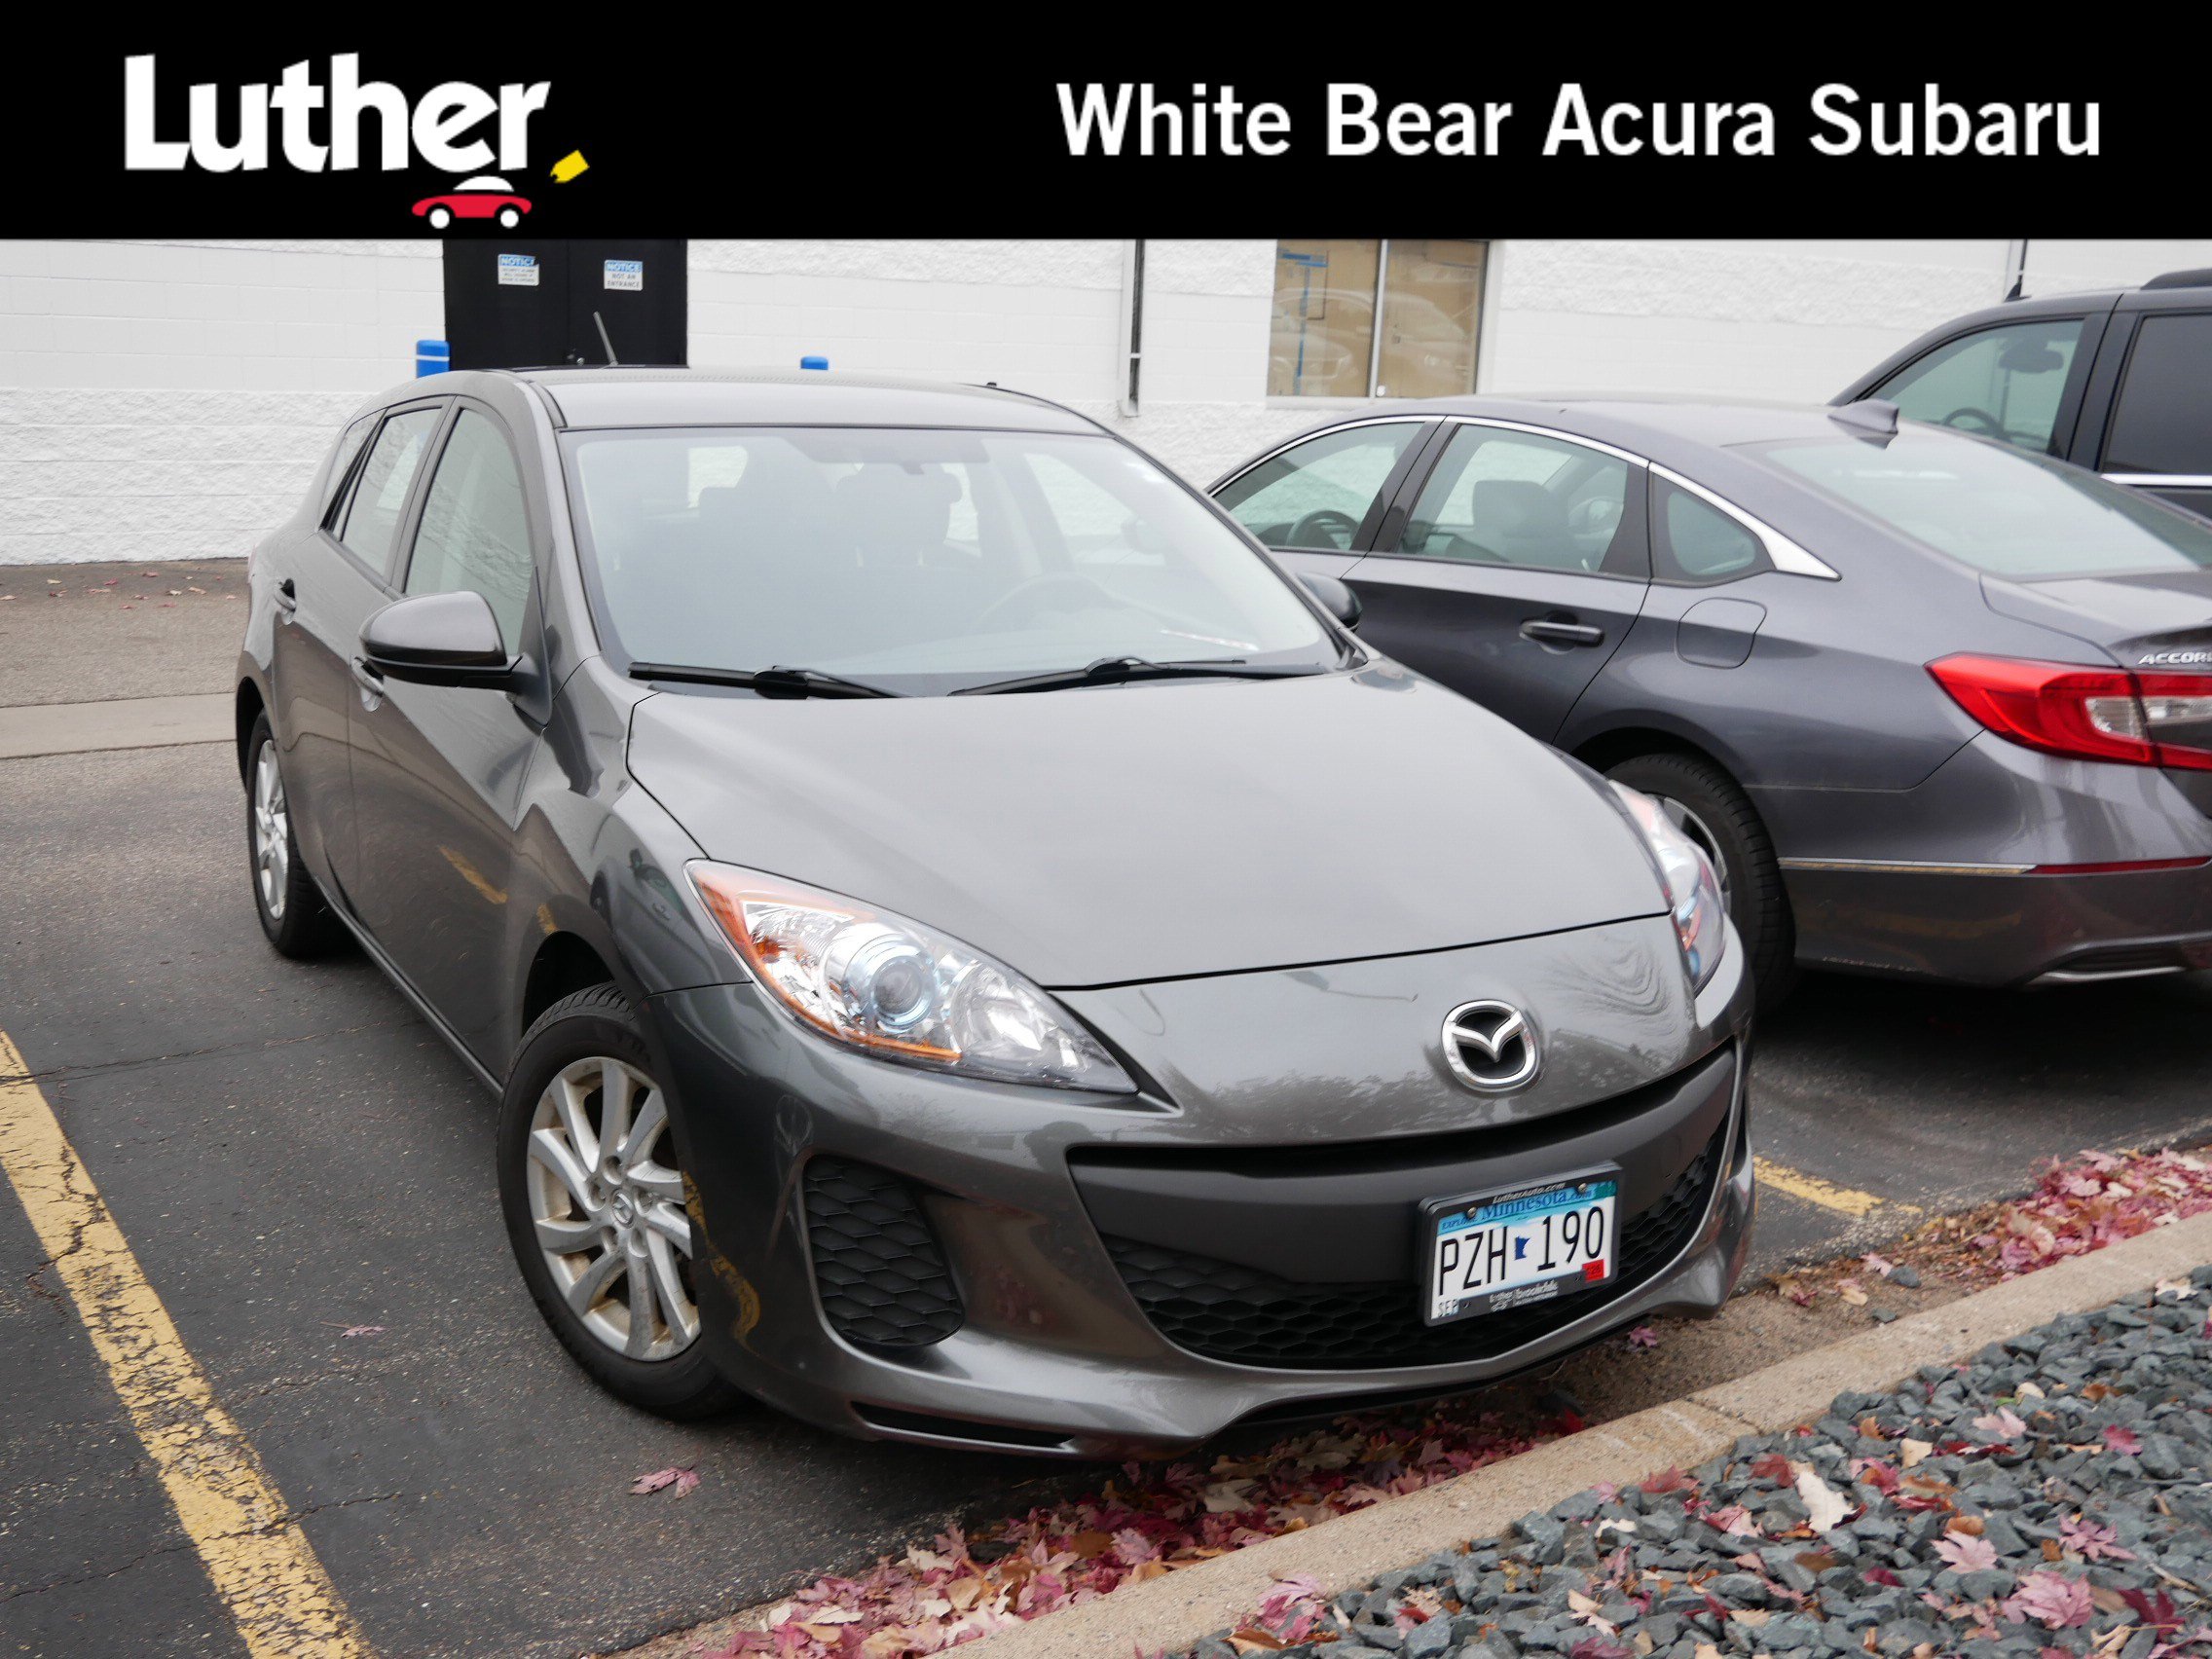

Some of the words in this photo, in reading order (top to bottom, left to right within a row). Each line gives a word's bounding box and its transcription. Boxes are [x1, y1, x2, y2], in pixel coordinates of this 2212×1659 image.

[607, 262, 642, 273] NOTICE
[1439, 1225, 1508, 1297] PZH
[1537, 1205, 1604, 1272] 190
